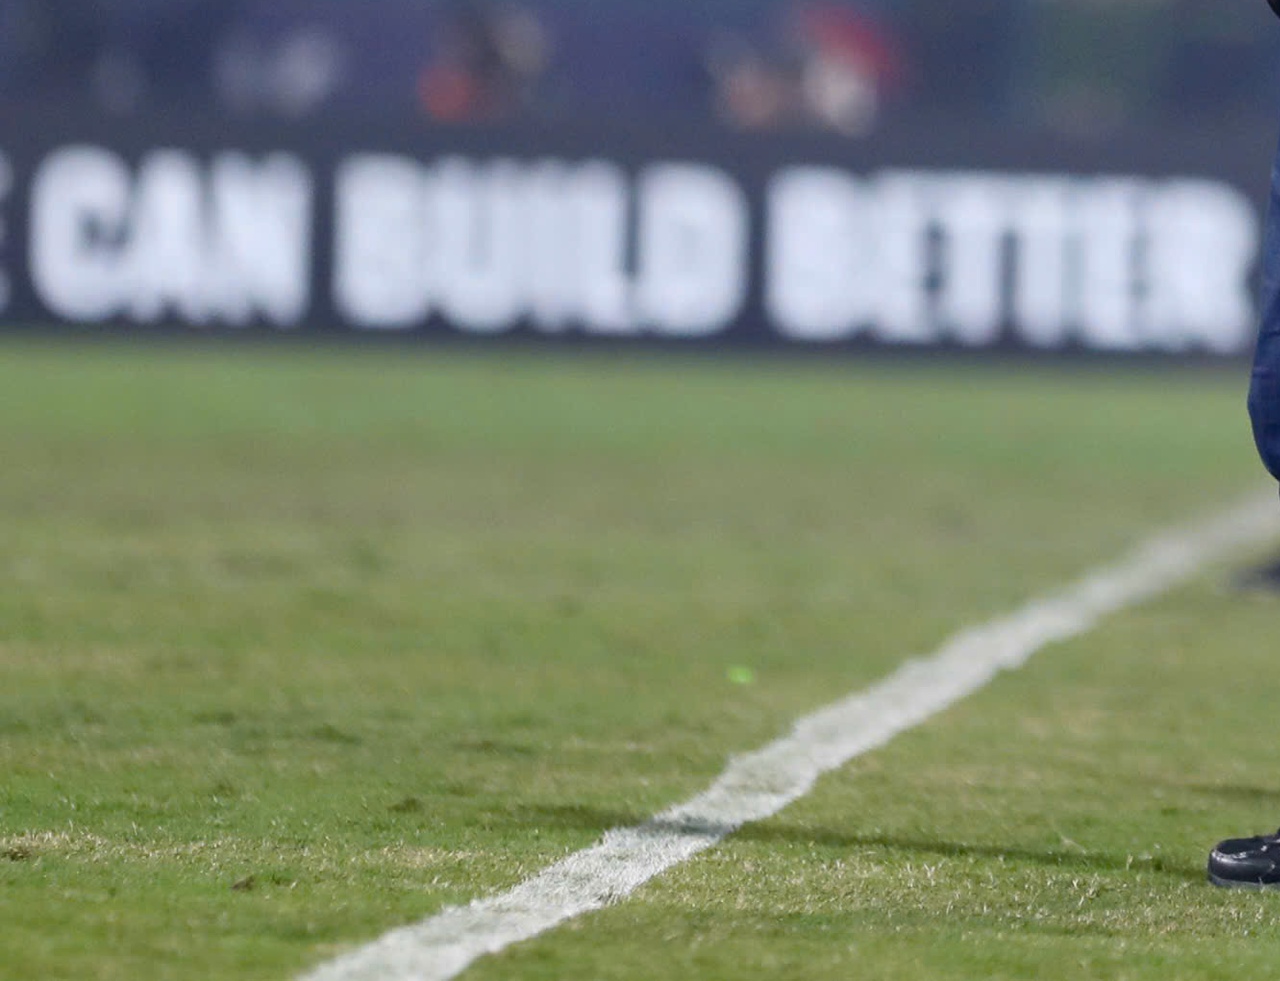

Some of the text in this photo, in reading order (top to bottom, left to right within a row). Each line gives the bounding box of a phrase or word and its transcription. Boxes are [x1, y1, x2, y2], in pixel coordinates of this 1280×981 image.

[29, 145, 311, 327] CAN
[334, 153, 749, 337] BUILD
[766, 165, 1258, 355] BETTER
